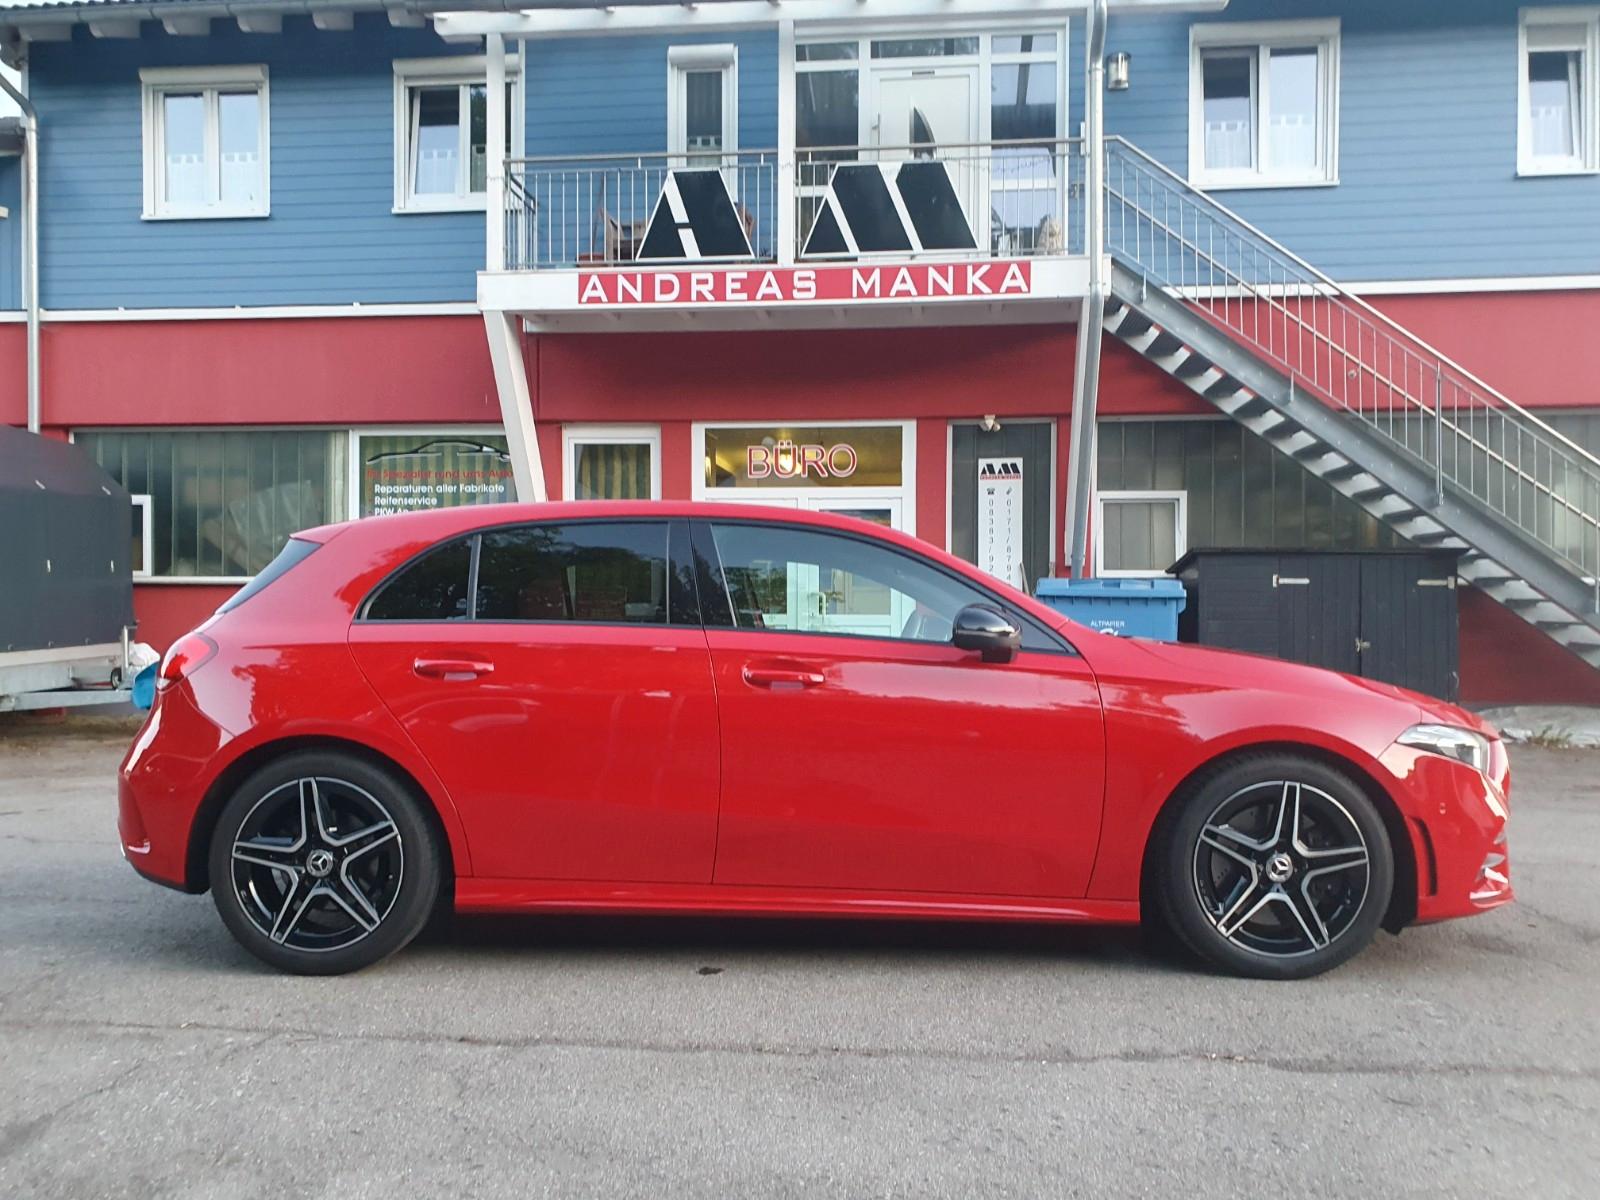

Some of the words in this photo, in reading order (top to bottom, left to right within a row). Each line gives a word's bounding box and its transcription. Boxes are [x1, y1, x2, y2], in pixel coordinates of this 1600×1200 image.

[580, 270, 817, 303] ANDREAS
[851, 262, 1030, 297] MANKA
[747, 440, 857, 479] BÜRO
[374, 484, 434, 495] Reparaturen
[435, 484, 457, 493] aller
[459, 484, 505, 493] Fabrikate
[374, 496, 438, 506] Reifenservice
[1090, 620, 1125, 628] ALTPAPIER
